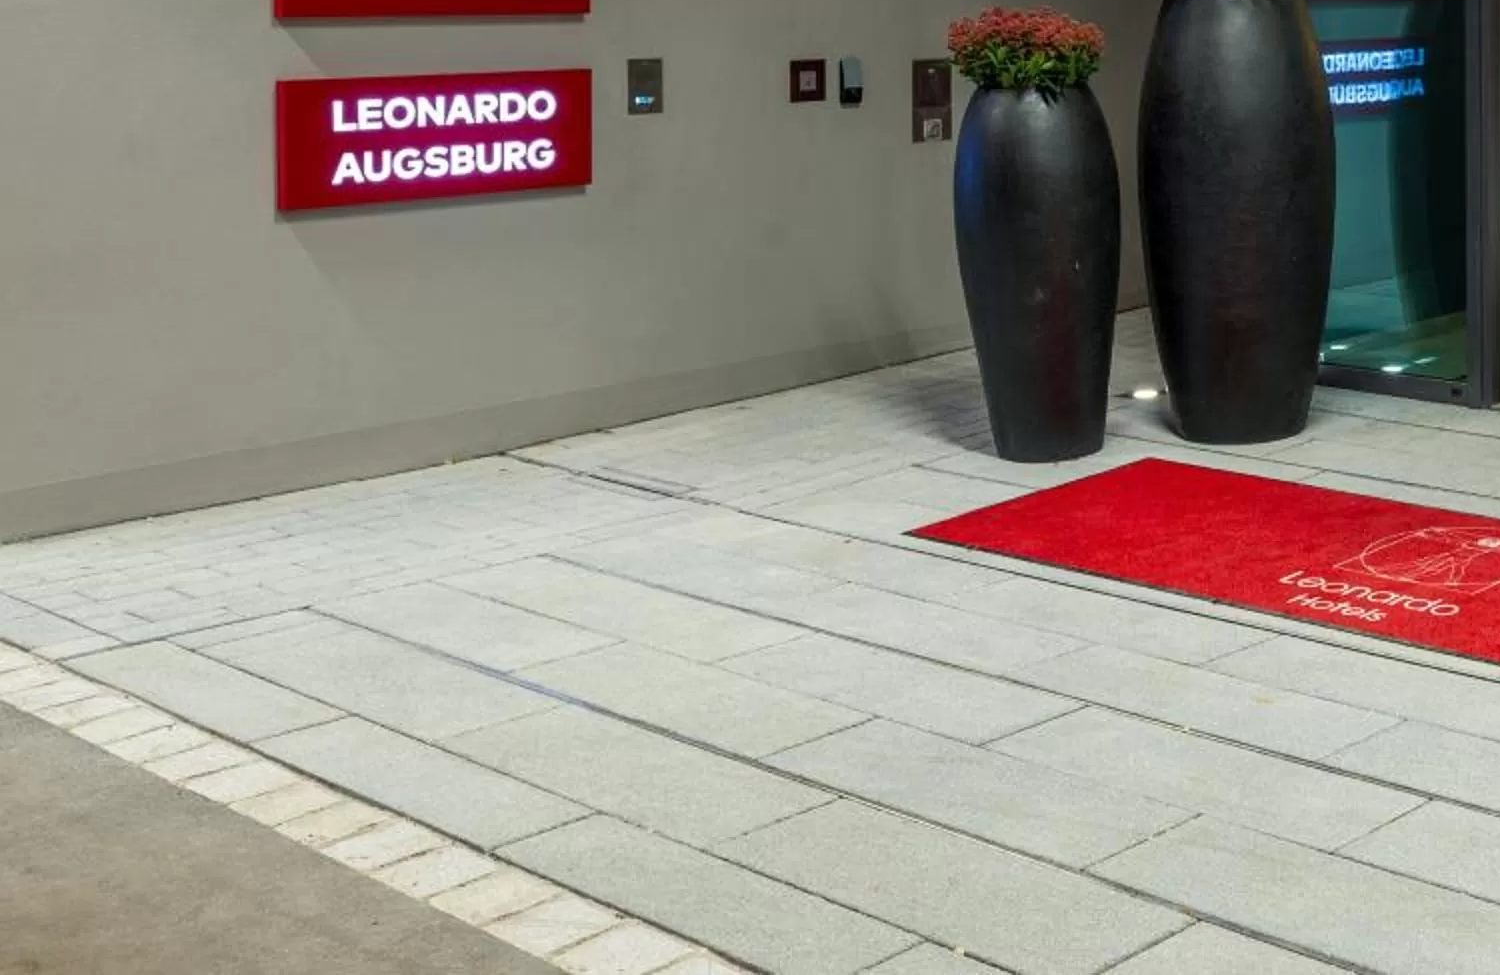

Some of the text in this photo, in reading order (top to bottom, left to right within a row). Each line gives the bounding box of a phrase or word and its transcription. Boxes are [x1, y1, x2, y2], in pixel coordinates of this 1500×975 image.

[332, 90, 557, 133] LEONARDO
[331, 138, 556, 186] AUGSBURG
[1279, 570, 1460, 616] Leonardo
[1286, 593, 1387, 622] Hotels
